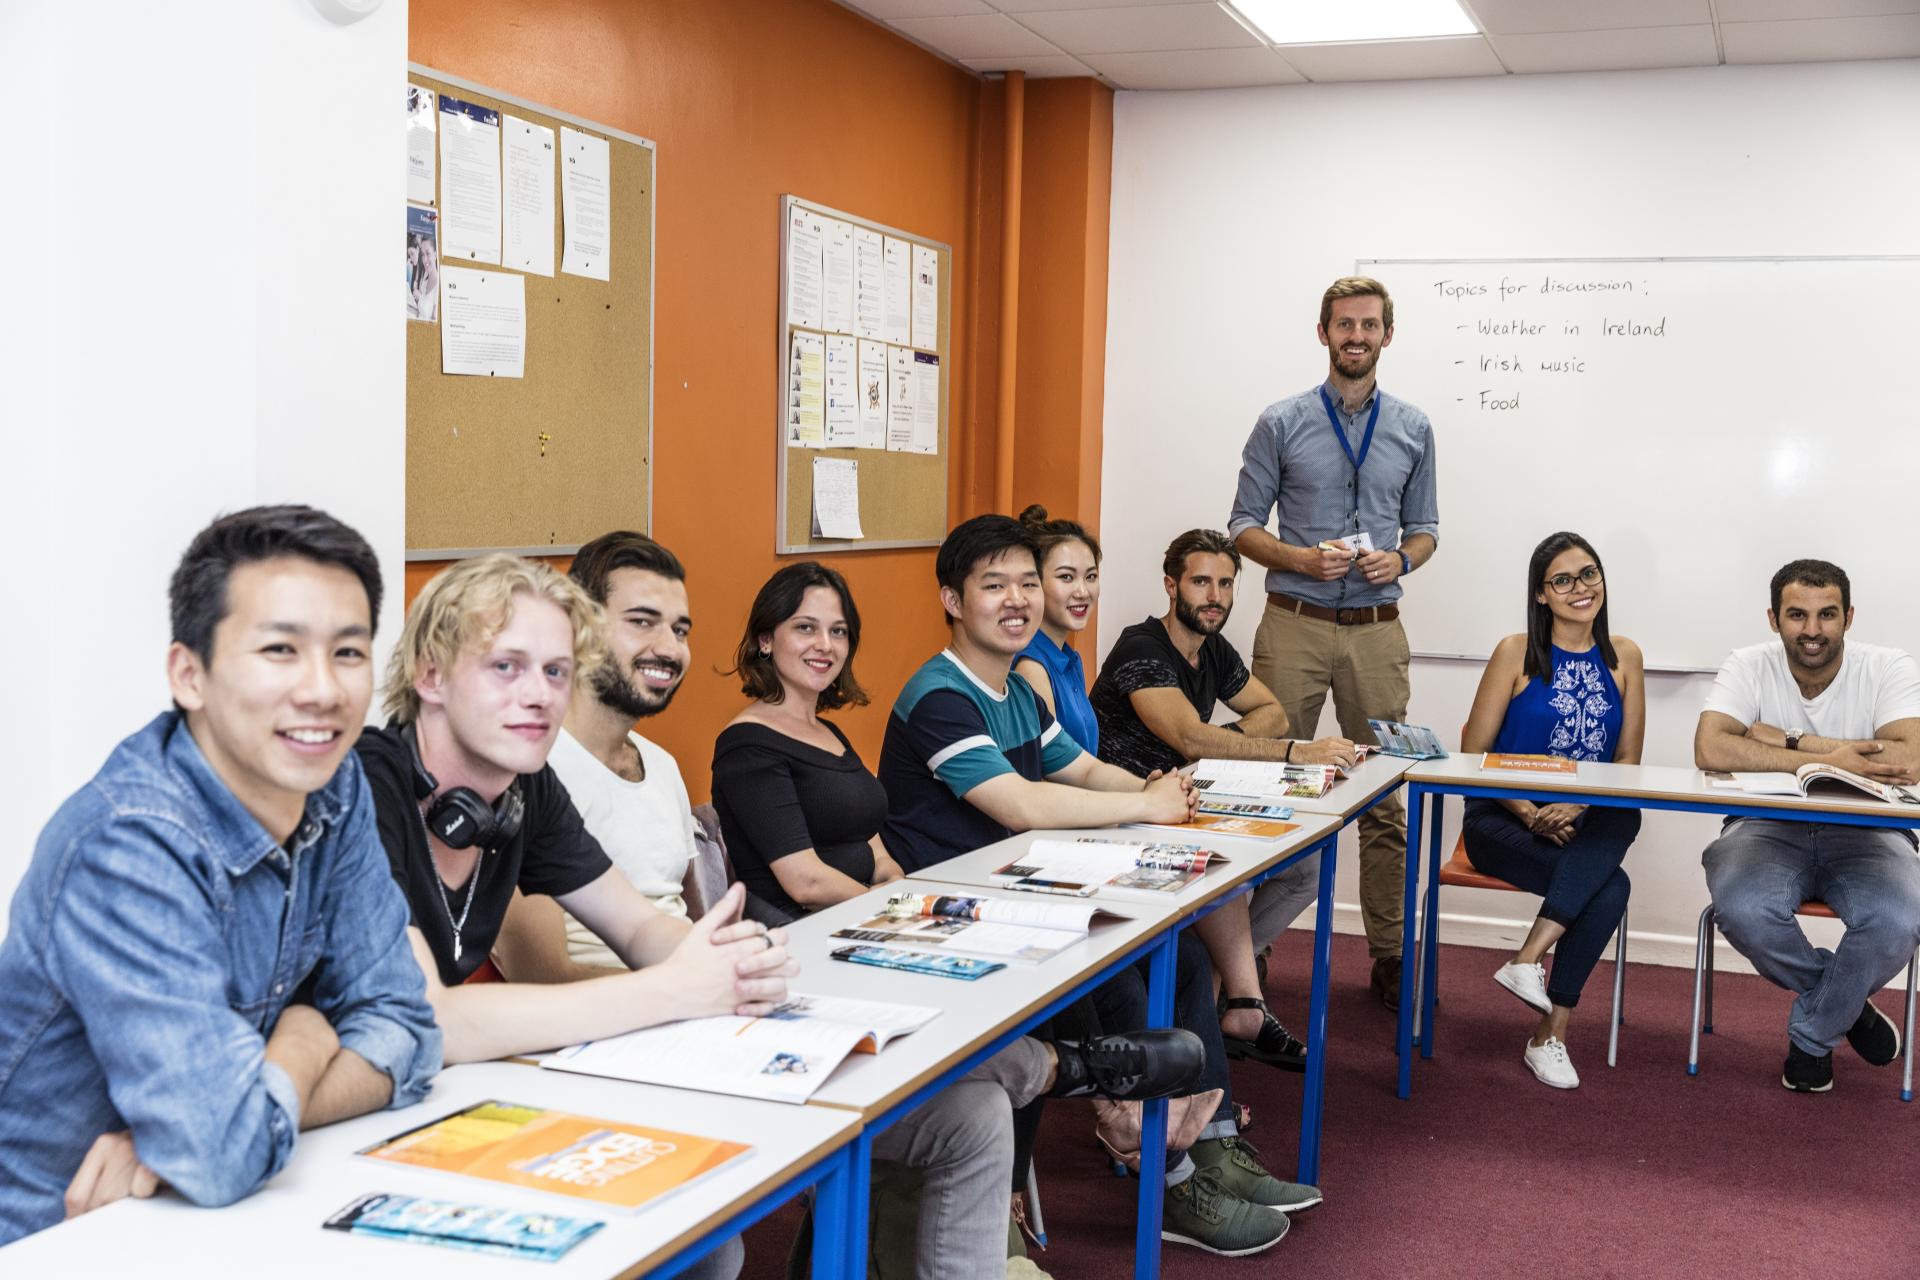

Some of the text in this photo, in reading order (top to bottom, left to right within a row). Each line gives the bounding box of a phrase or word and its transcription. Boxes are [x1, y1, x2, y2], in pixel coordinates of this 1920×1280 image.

[1433, 279, 1488, 302] Topics
[1498, 276, 1528, 302] for
[1478, 319, 1547, 336] Weather
[1564, 319, 1580, 336] in
[1602, 317, 1666, 337] Ireland
[1480, 354, 1523, 372] Irish
[1540, 356, 1586, 373] music
[1479, 390, 1520, 411] Food
